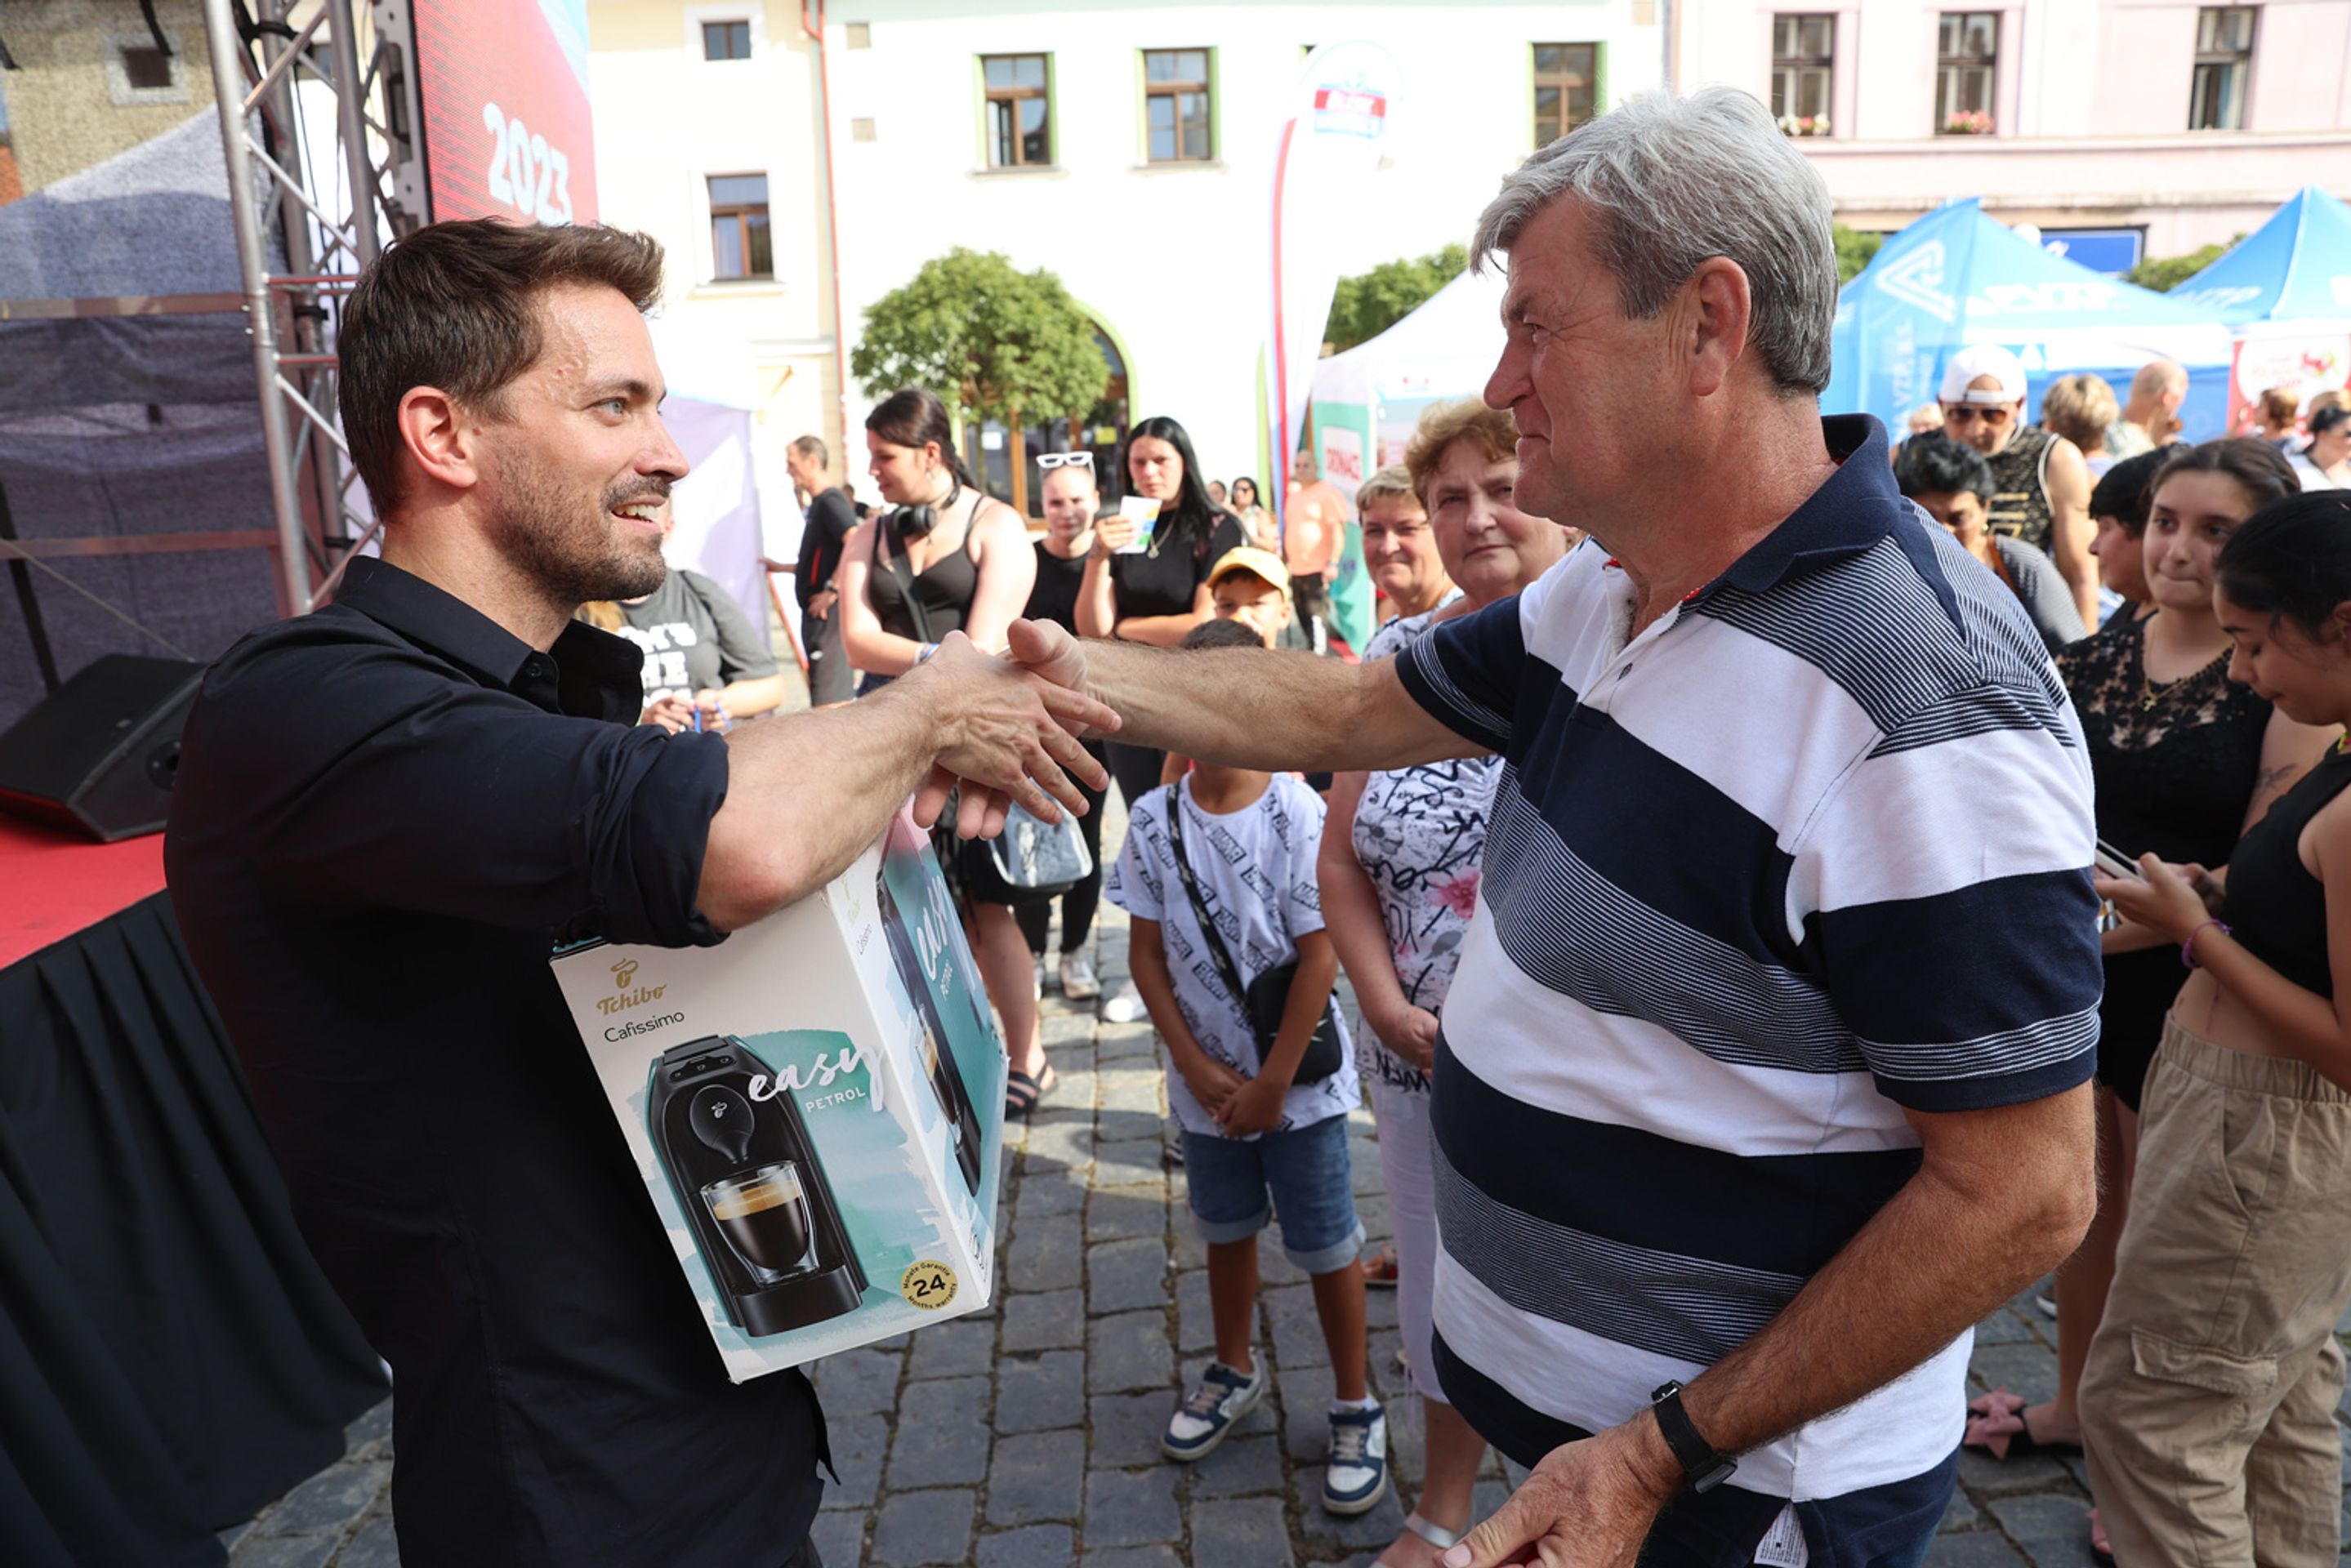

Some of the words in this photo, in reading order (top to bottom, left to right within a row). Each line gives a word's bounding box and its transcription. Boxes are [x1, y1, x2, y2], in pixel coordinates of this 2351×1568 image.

[482, 101, 573, 227] 2023
[596, 983, 667, 1016] Tchibo
[604, 1011, 685, 1043] Cafissimo
[748, 1045, 885, 1113] easy
[805, 1086, 866, 1113] PETROL
[912, 1274, 946, 1298] 24
